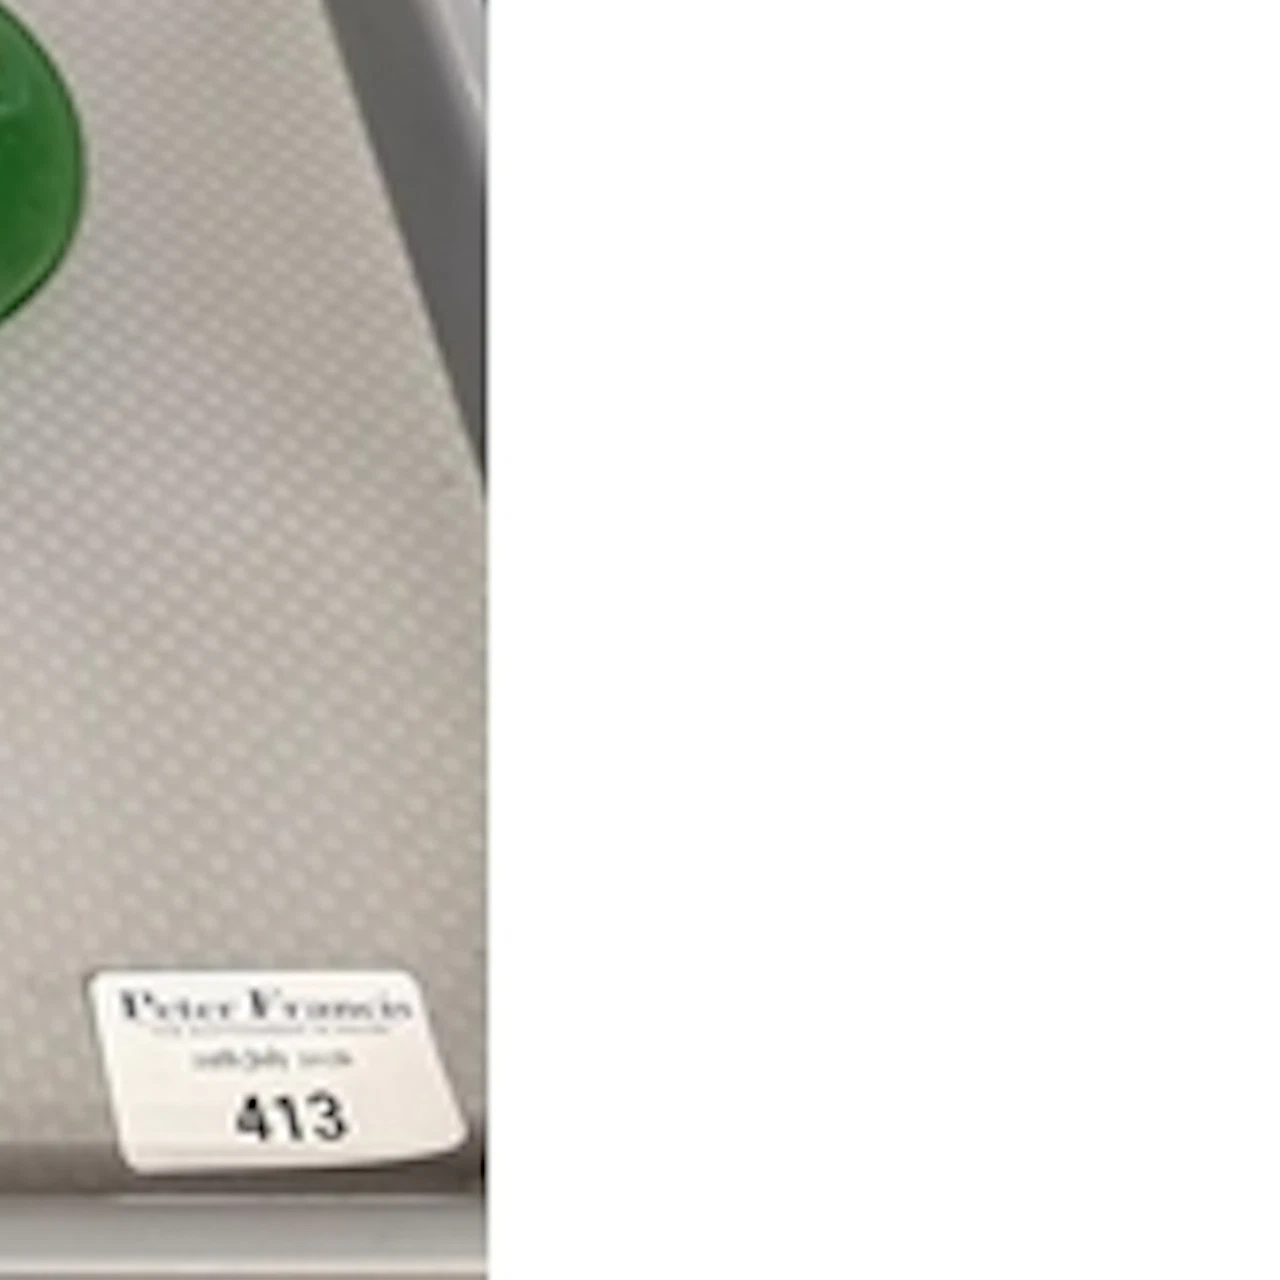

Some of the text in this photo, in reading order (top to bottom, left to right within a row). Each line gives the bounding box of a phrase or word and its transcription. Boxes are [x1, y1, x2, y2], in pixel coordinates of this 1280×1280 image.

[118, 989, 413, 1020] Peter Francis
[236, 1090, 349, 1142] 413
